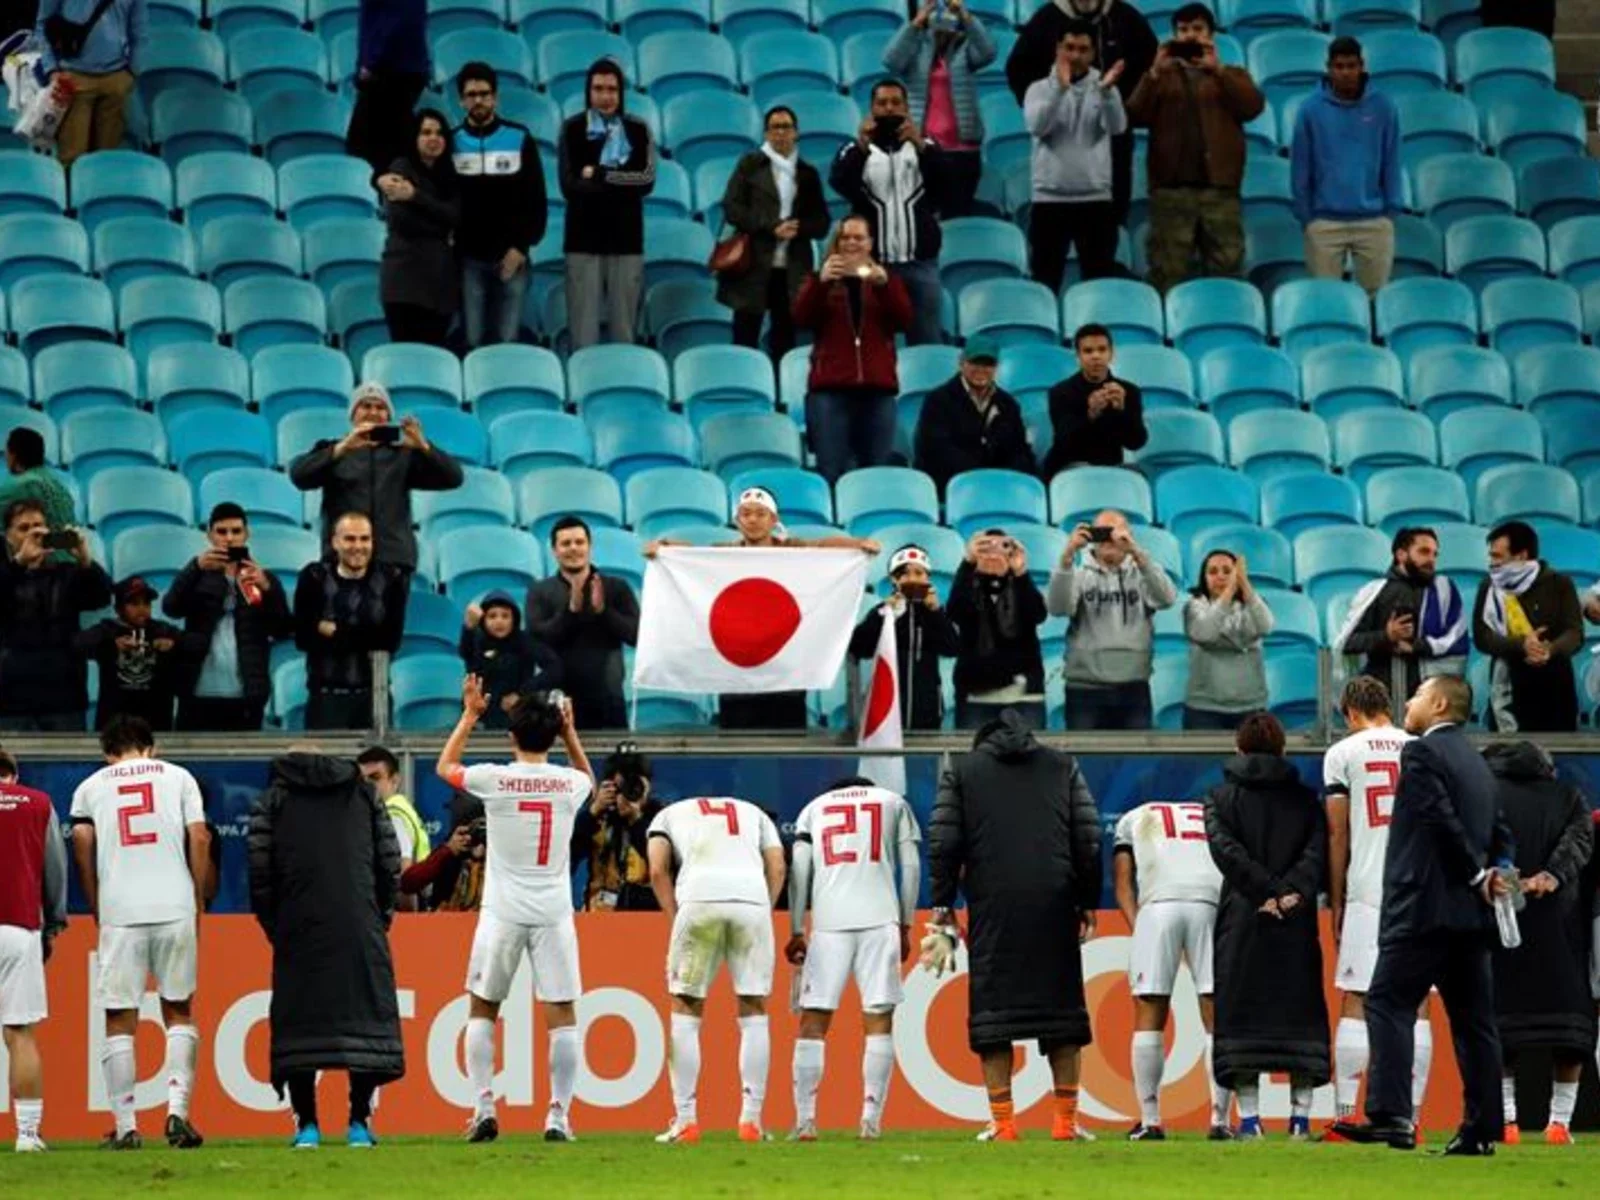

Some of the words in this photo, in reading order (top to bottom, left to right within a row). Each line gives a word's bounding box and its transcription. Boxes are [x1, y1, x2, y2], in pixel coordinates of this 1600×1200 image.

[1367, 739, 1405, 752] TATS
[117, 781, 158, 848] 2
[518, 801, 552, 867] 7
[698, 799, 740, 836] 4
[822, 802, 882, 867] 21
[1149, 804, 1208, 840] 13
[87, 950, 665, 1112] bodo
